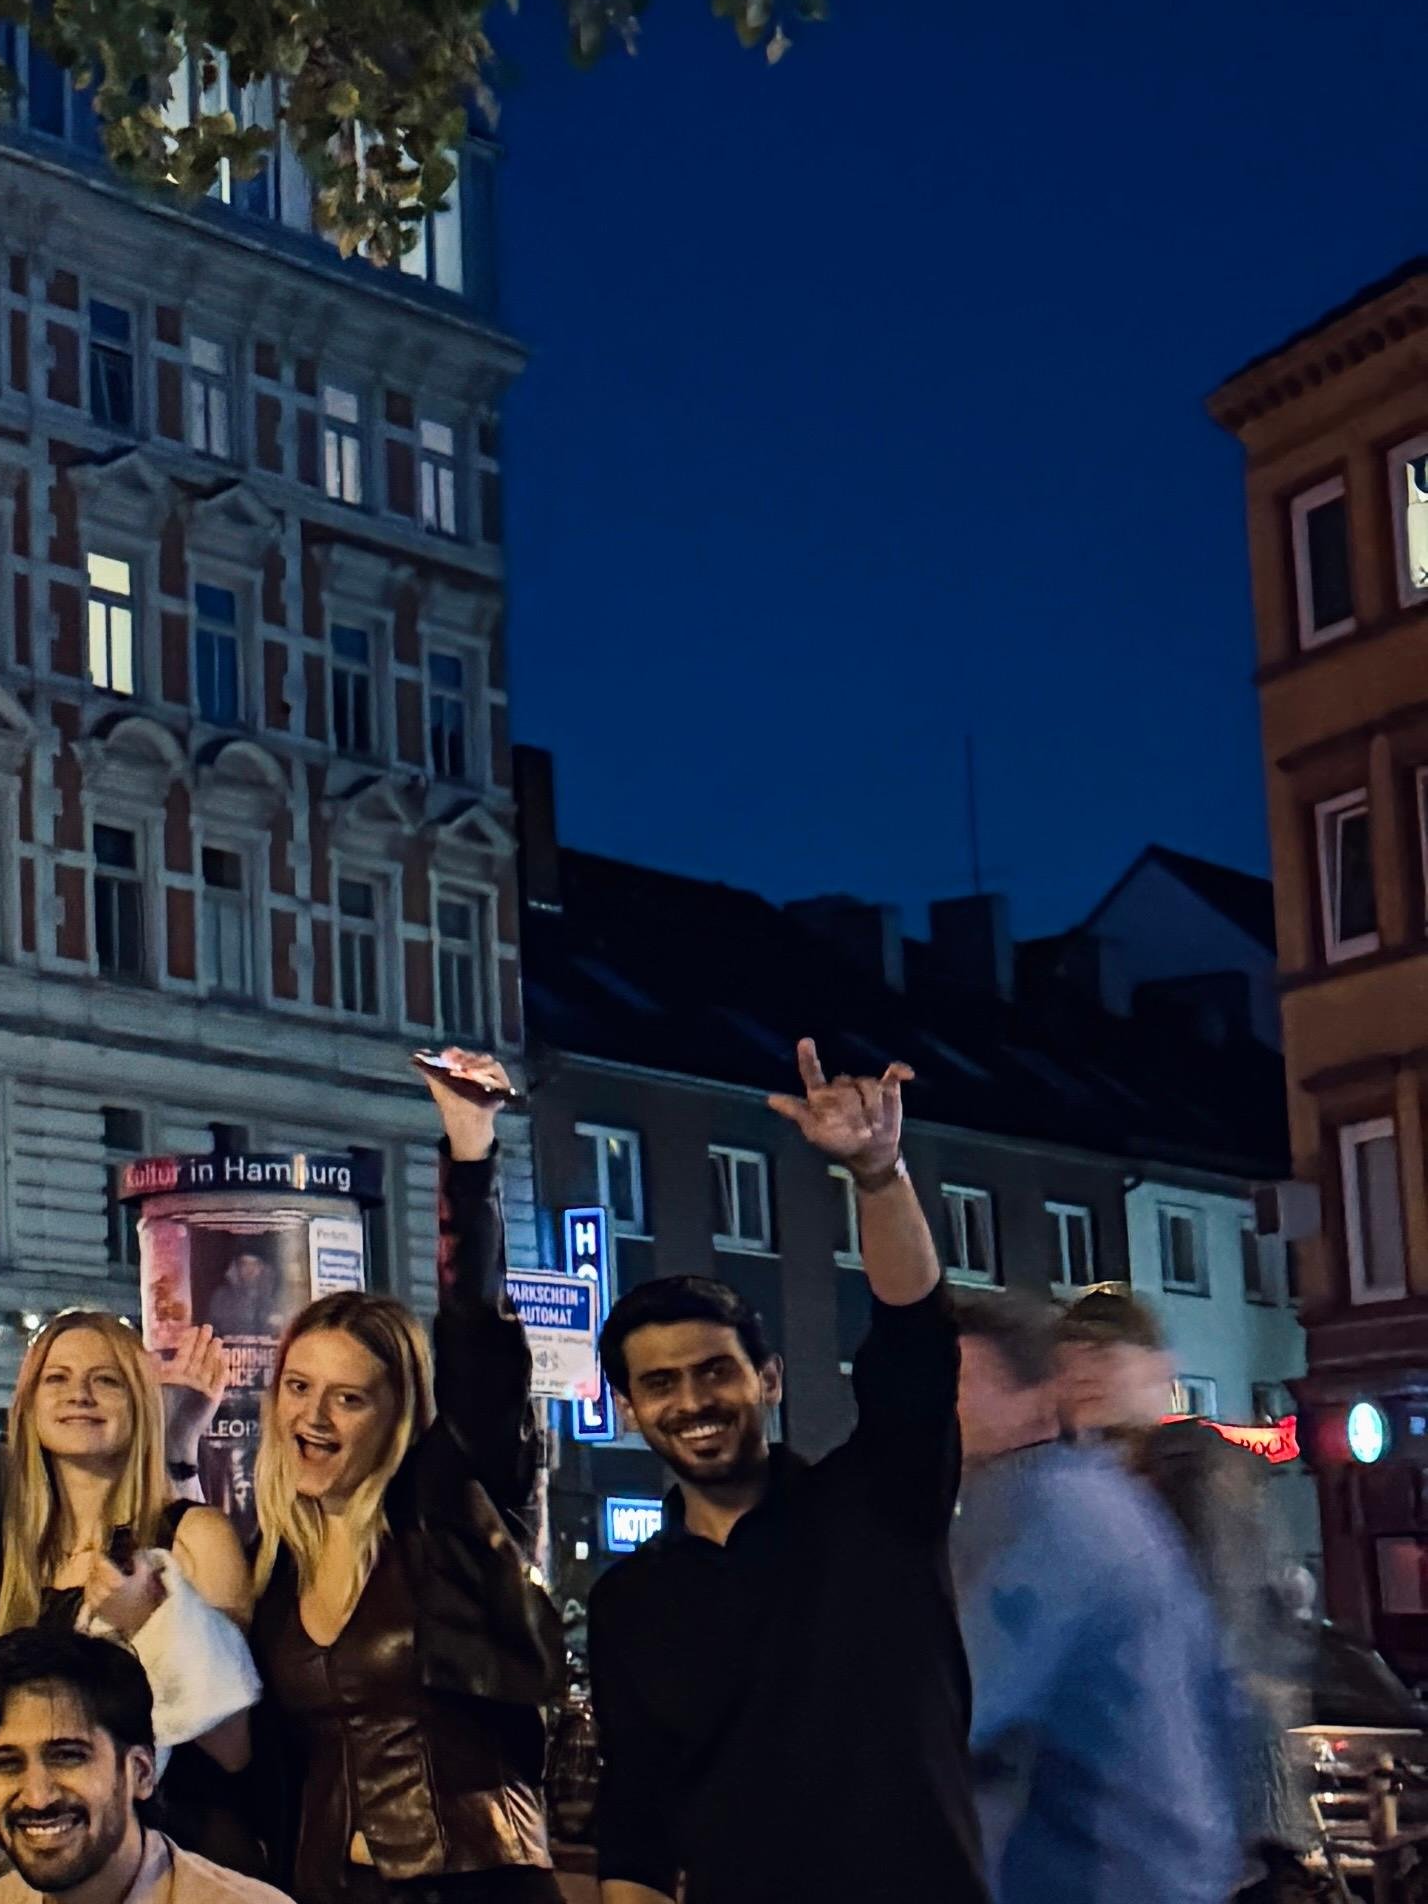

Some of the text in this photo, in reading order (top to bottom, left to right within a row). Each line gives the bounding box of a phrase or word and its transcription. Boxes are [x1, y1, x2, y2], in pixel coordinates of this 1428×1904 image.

[189, 1158, 214, 1183] in
[519, 1306, 573, 1327] AUTOMAT
[612, 1506, 662, 1543] HOTE
